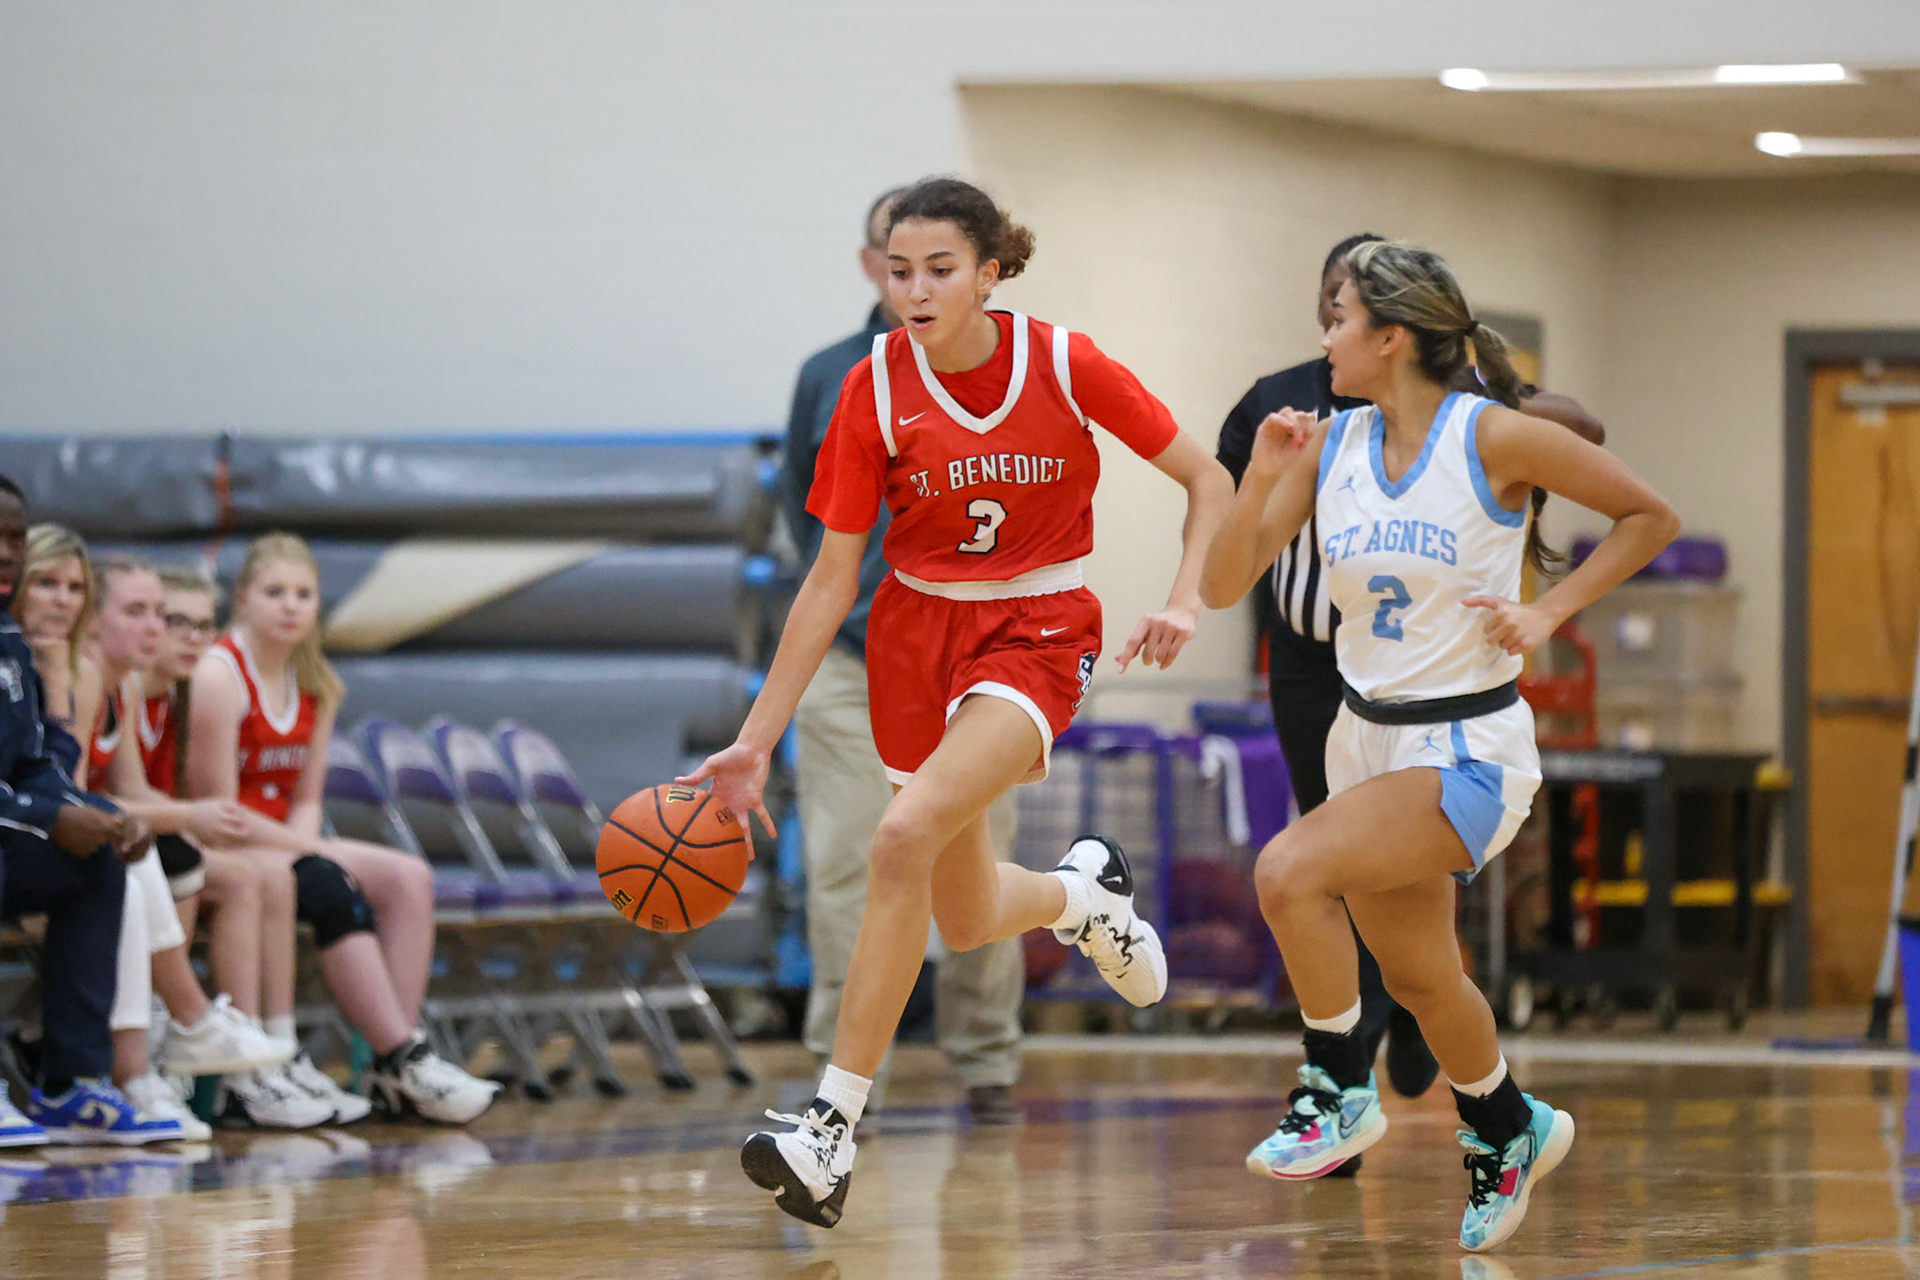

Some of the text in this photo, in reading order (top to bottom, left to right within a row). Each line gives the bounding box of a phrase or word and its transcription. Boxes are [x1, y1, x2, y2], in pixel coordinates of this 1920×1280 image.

[909, 453, 1066, 497] ST. BENEDICT
[955, 498, 1009, 554] 3
[1325, 519, 1457, 568] ST. AGNES
[1367, 575, 1413, 642] 2
